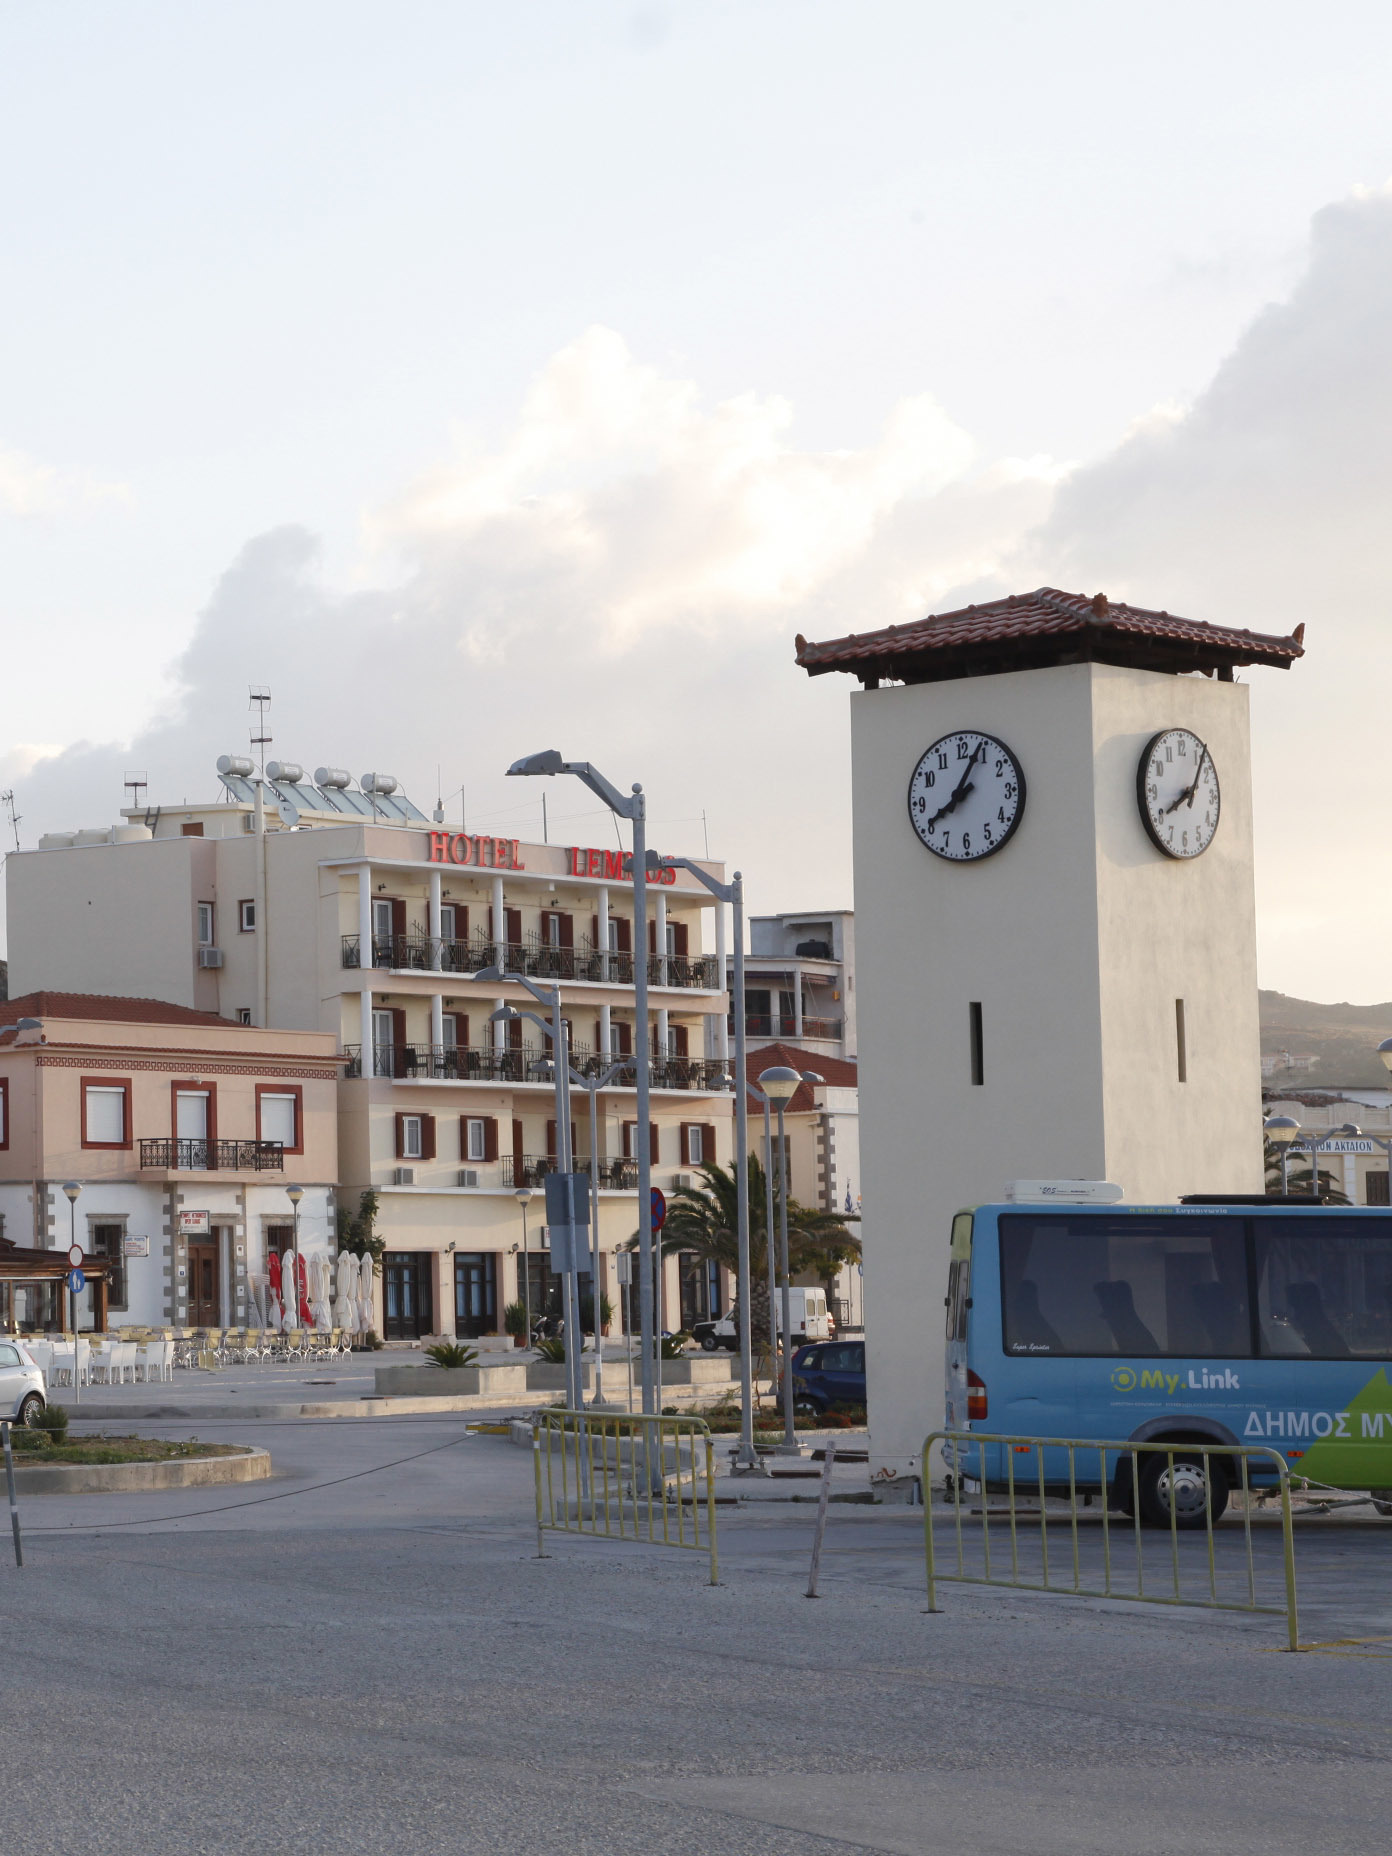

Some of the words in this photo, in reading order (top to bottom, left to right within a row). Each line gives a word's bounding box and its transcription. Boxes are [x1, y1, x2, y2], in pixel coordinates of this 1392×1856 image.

[956, 741, 968, 760] 12
[981, 747, 987, 764] 1
[1165, 746, 1173, 763] 11
[1177, 739, 1186, 757] 12
[938, 753, 948, 770] 11
[1193, 749, 1198, 766] 1
[995, 760, 1003, 778] 2
[1155, 760, 1164, 777] 10
[1203, 767, 1209, 784] 2
[924, 770, 935, 788] 10
[1004, 782, 1012, 800] 3
[1151, 783, 1157, 801] 9
[1209, 788, 1215, 805] 3
[918, 796, 926, 813] 9
[997, 806, 1005, 824] 4
[1158, 808, 1164, 825] 8
[1205, 810, 1210, 827] 4
[943, 831, 950, 848] 7
[983, 822, 991, 840] 5
[1168, 825, 1174, 842] 7
[1182, 830, 1188, 847] 6
[1196, 825, 1201, 842] 5
[962, 832, 970, 850] 6
[429, 831, 525, 870] HOTEL
[1335, 1141, 1372, 1152] ΑΚΤΑΙΟΝ
[1140, 1367, 1240, 1395] My.Link
[1244, 1411, 1352, 1437] ΔΗΜΟΣ
